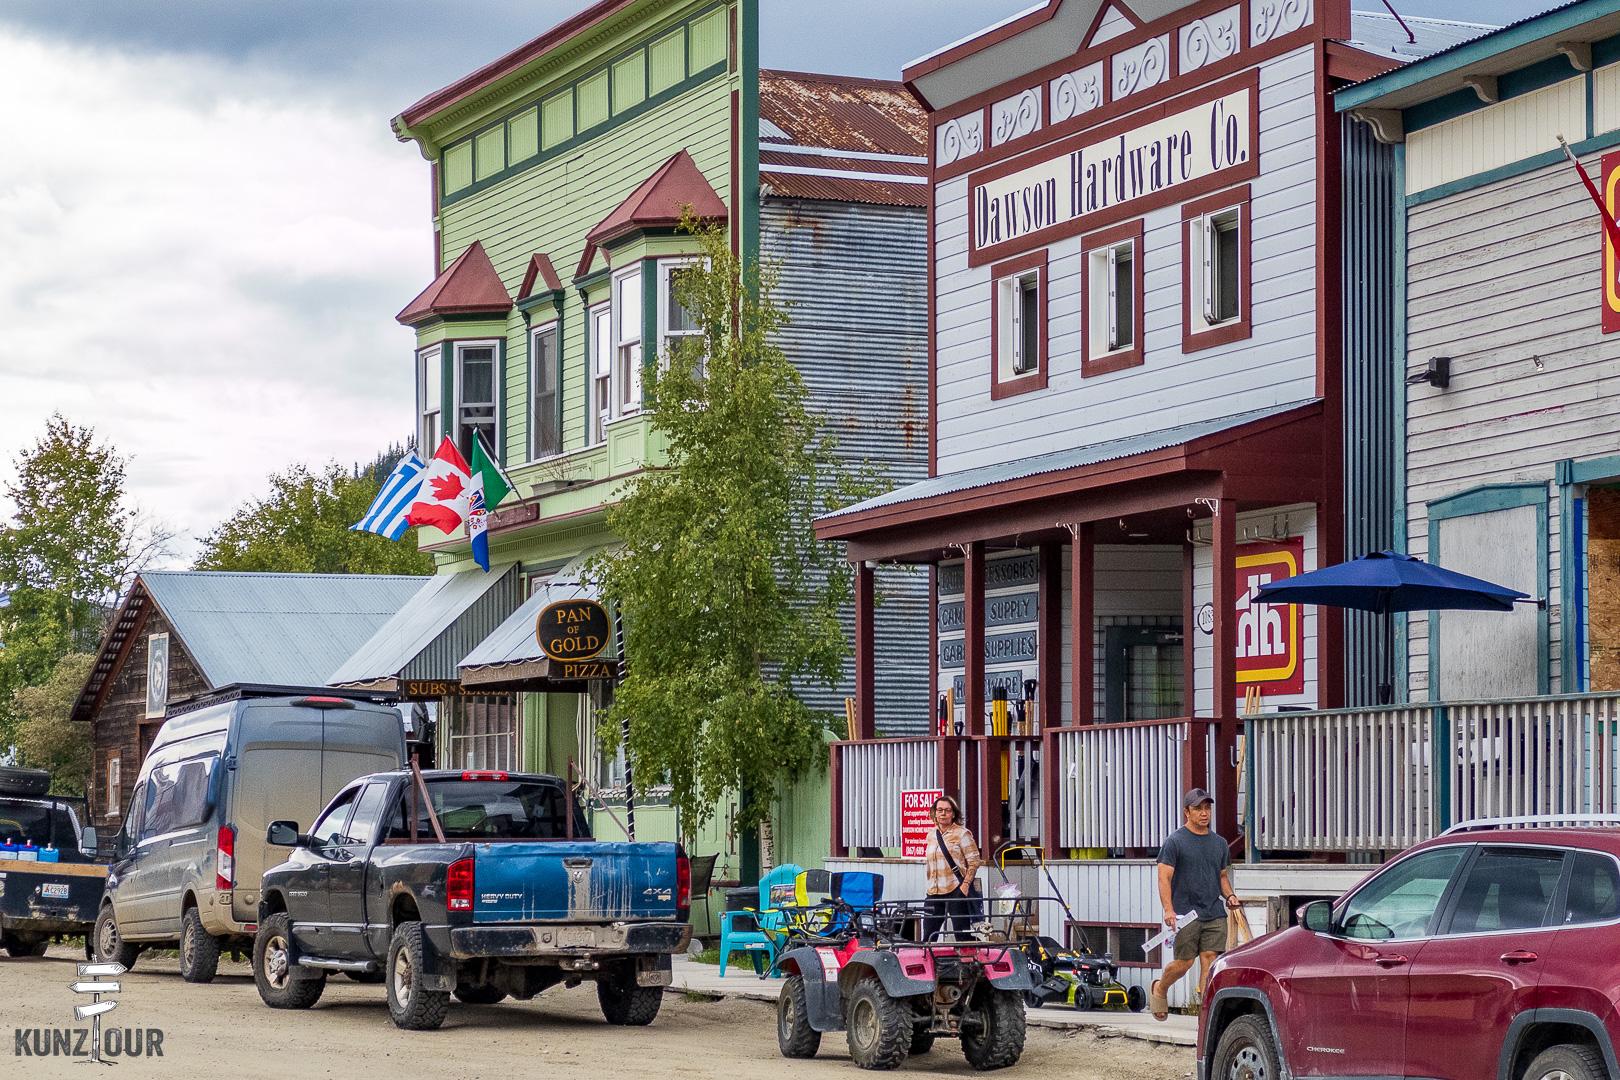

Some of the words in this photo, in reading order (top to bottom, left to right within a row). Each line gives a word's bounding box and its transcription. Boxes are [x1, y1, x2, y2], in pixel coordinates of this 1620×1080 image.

[976, 176, 1057, 248] Dawson
[1070, 130, 1192, 218] Hardware
[1210, 99, 1246, 170] Co.
[557, 607, 591, 624] PAN
[990, 600, 1030, 620] SUPPLY
[567, 626, 579, 634] OF
[550, 635, 599, 654] GOLD
[985, 636, 1034, 659] SUPPLIES
[564, 664, 611, 678] PIZZA
[409, 682, 447, 696] SUBS
[904, 793, 919, 808] FOR
